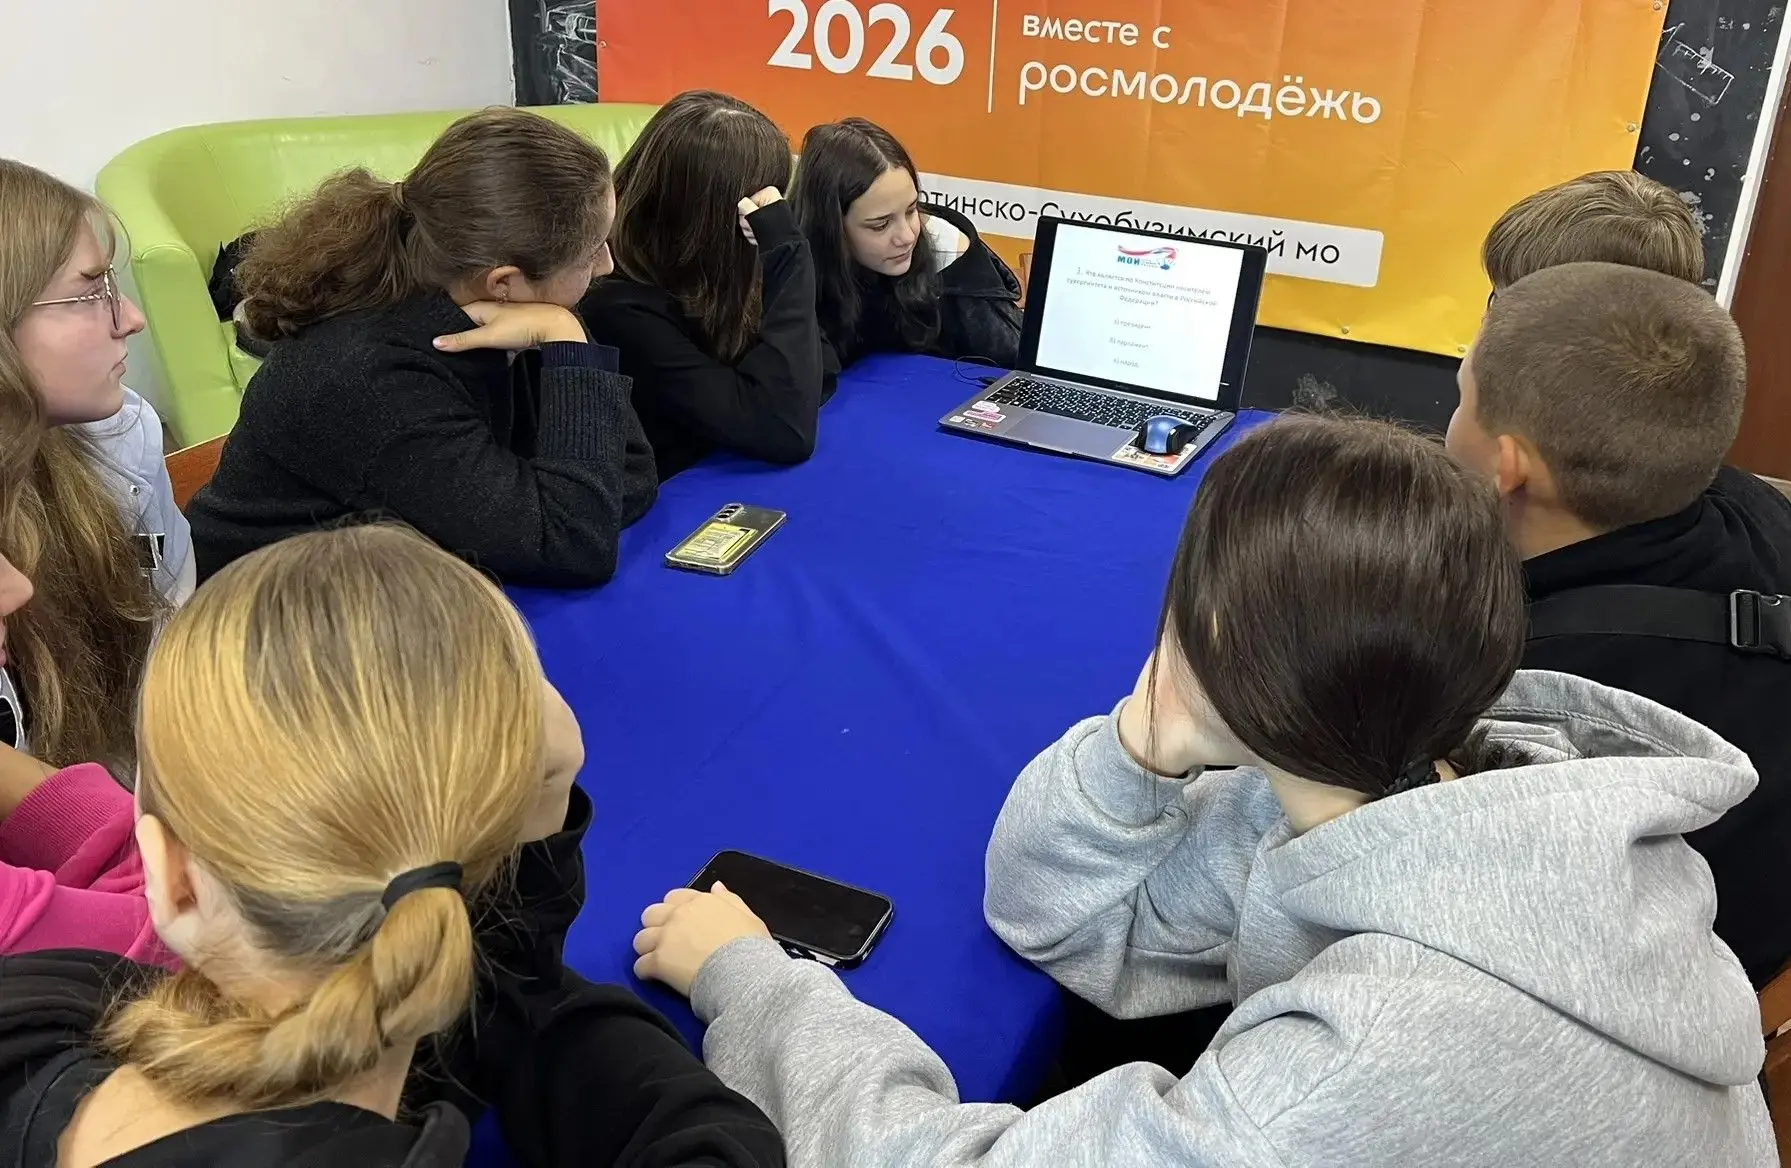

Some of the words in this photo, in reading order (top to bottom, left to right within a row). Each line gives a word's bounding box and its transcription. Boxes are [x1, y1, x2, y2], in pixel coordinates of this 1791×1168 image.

[766, 0, 965, 86] 2026
[1022, 14, 1139, 47] вместе
[1152, 25, 1172, 49] с
[1018, 61, 1382, 124] росмолодёжь
[1295, 241, 1340, 264] мо
[1097, 271, 1124, 281] является
